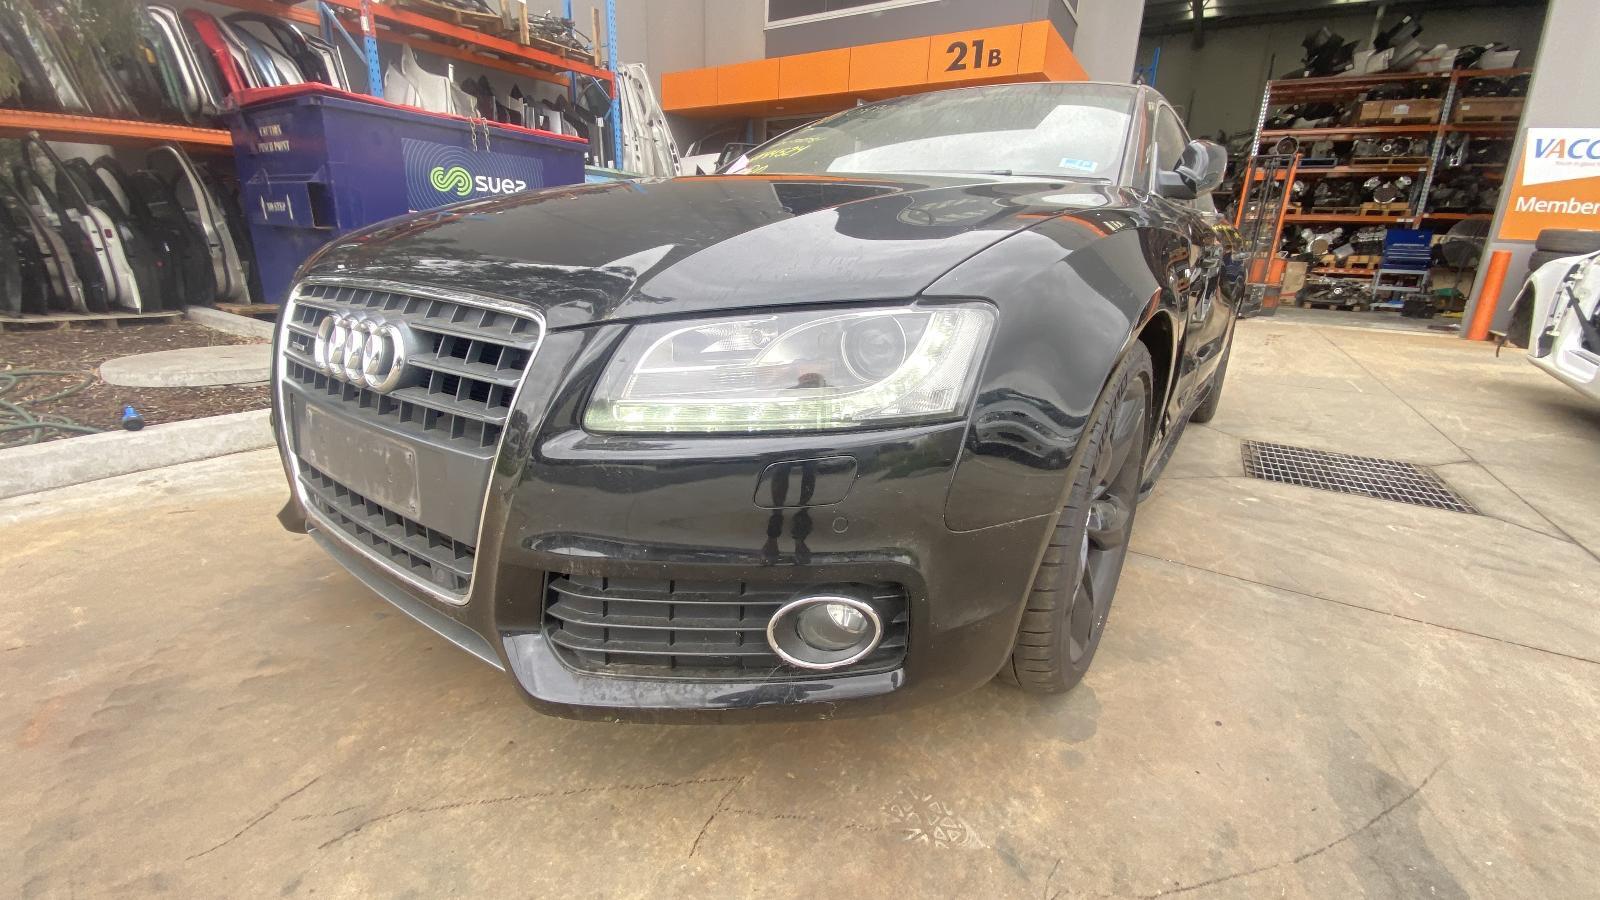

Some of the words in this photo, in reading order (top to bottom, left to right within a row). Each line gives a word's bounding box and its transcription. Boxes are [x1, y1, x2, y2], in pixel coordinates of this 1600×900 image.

[943, 39, 1002, 72] 21B
[1534, 138, 1600, 159] VACC
[1514, 196, 1600, 215] Member
